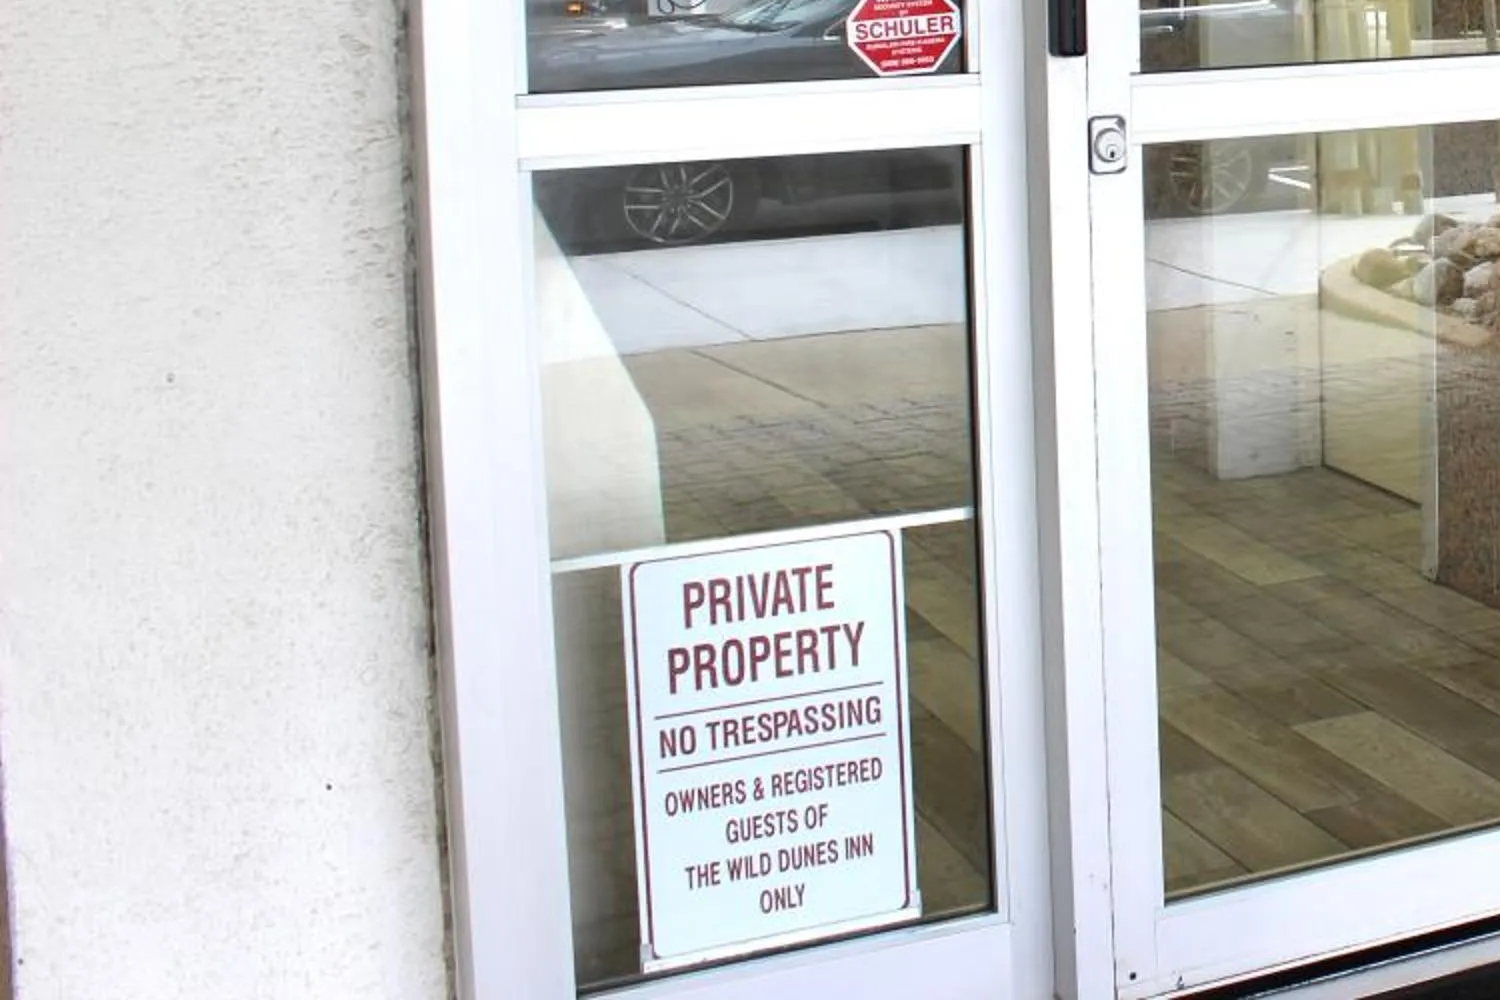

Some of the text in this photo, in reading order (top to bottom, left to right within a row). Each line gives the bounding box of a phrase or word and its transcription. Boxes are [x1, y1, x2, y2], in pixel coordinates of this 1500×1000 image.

[855, 16, 954, 40] SCHULER
[683, 564, 835, 629] PRIVATE
[667, 621, 865, 694] PROPERTY
[659, 696, 882, 758] NO TRESPASSING
[665, 757, 883, 817] OWNERS & REGISTERED
[726, 804, 829, 844] GUESTS OF
[685, 833, 874, 891] THE WILD DUNES INN
[760, 885, 806, 915] ONLY
